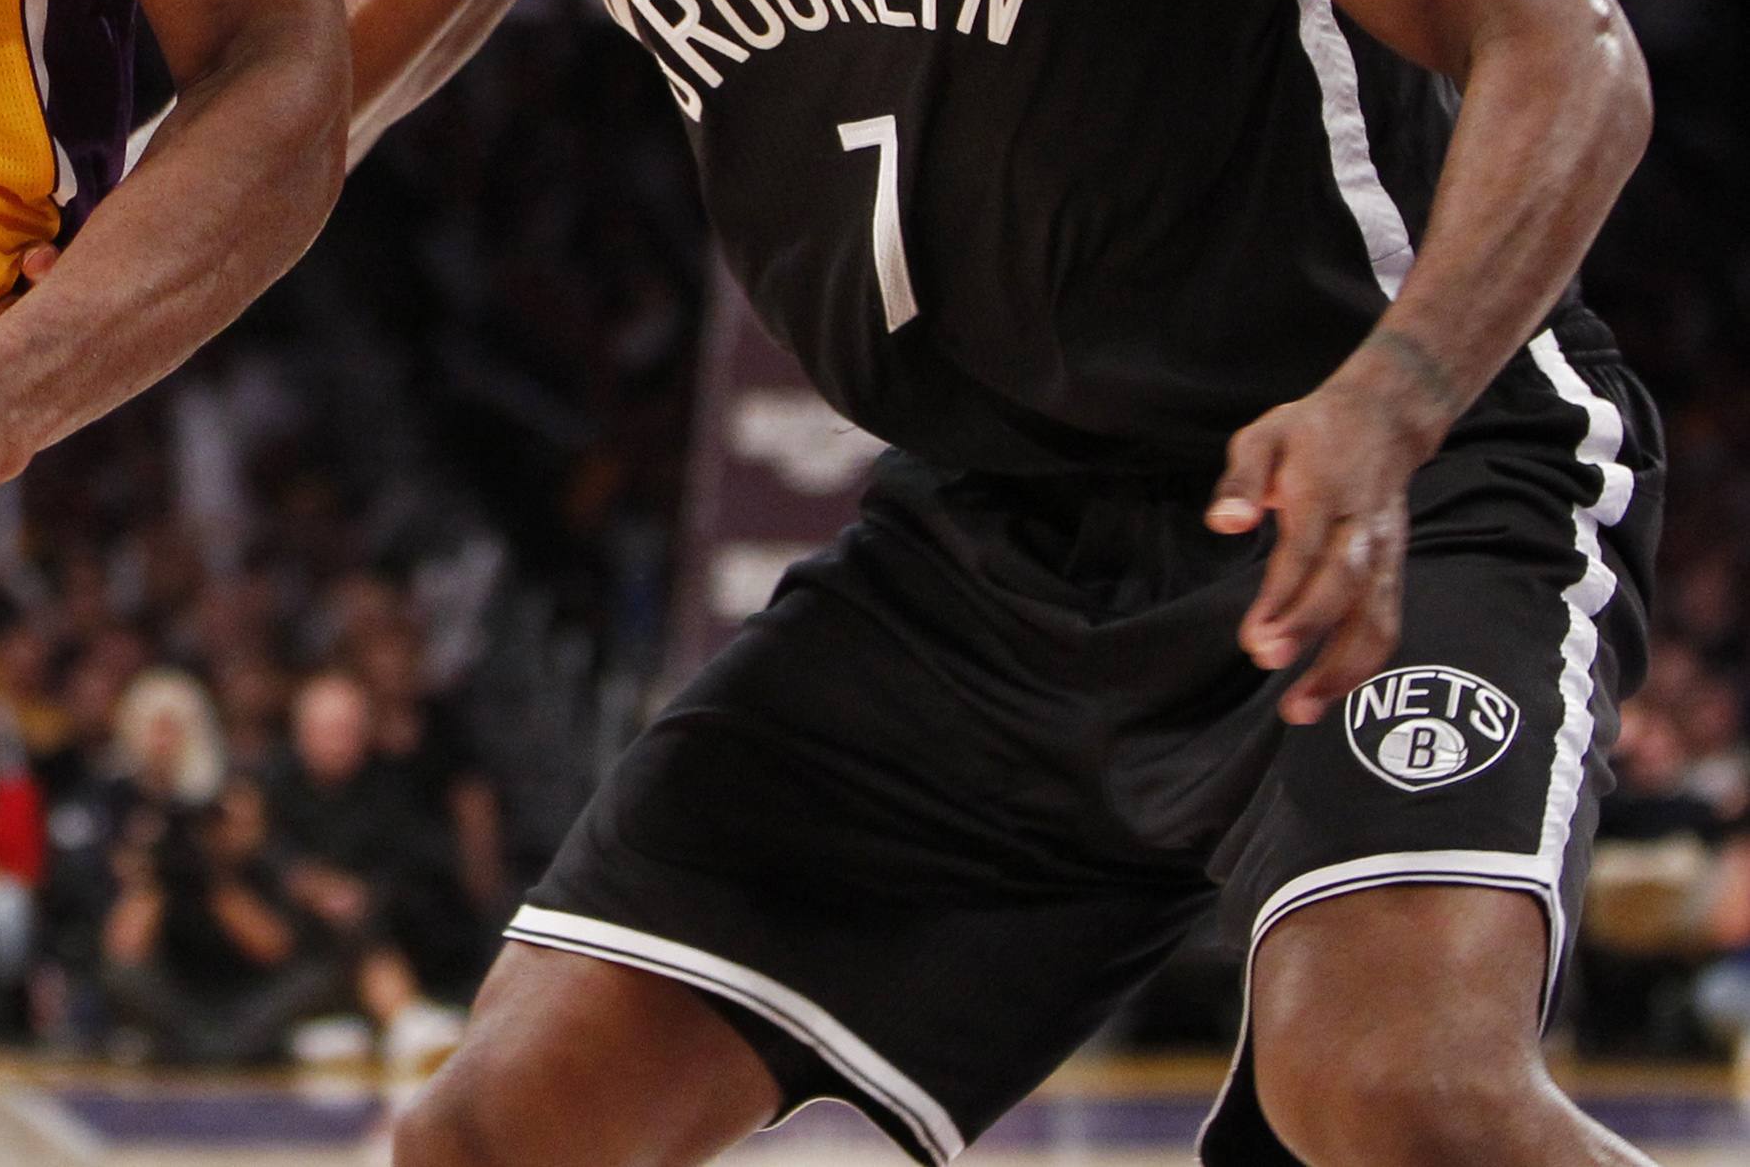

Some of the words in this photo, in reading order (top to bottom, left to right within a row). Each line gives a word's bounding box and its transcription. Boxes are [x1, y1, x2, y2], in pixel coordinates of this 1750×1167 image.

[837, 114, 919, 333] 7
[1354, 671, 1507, 742] NETS
[1407, 727, 1437, 769] B
